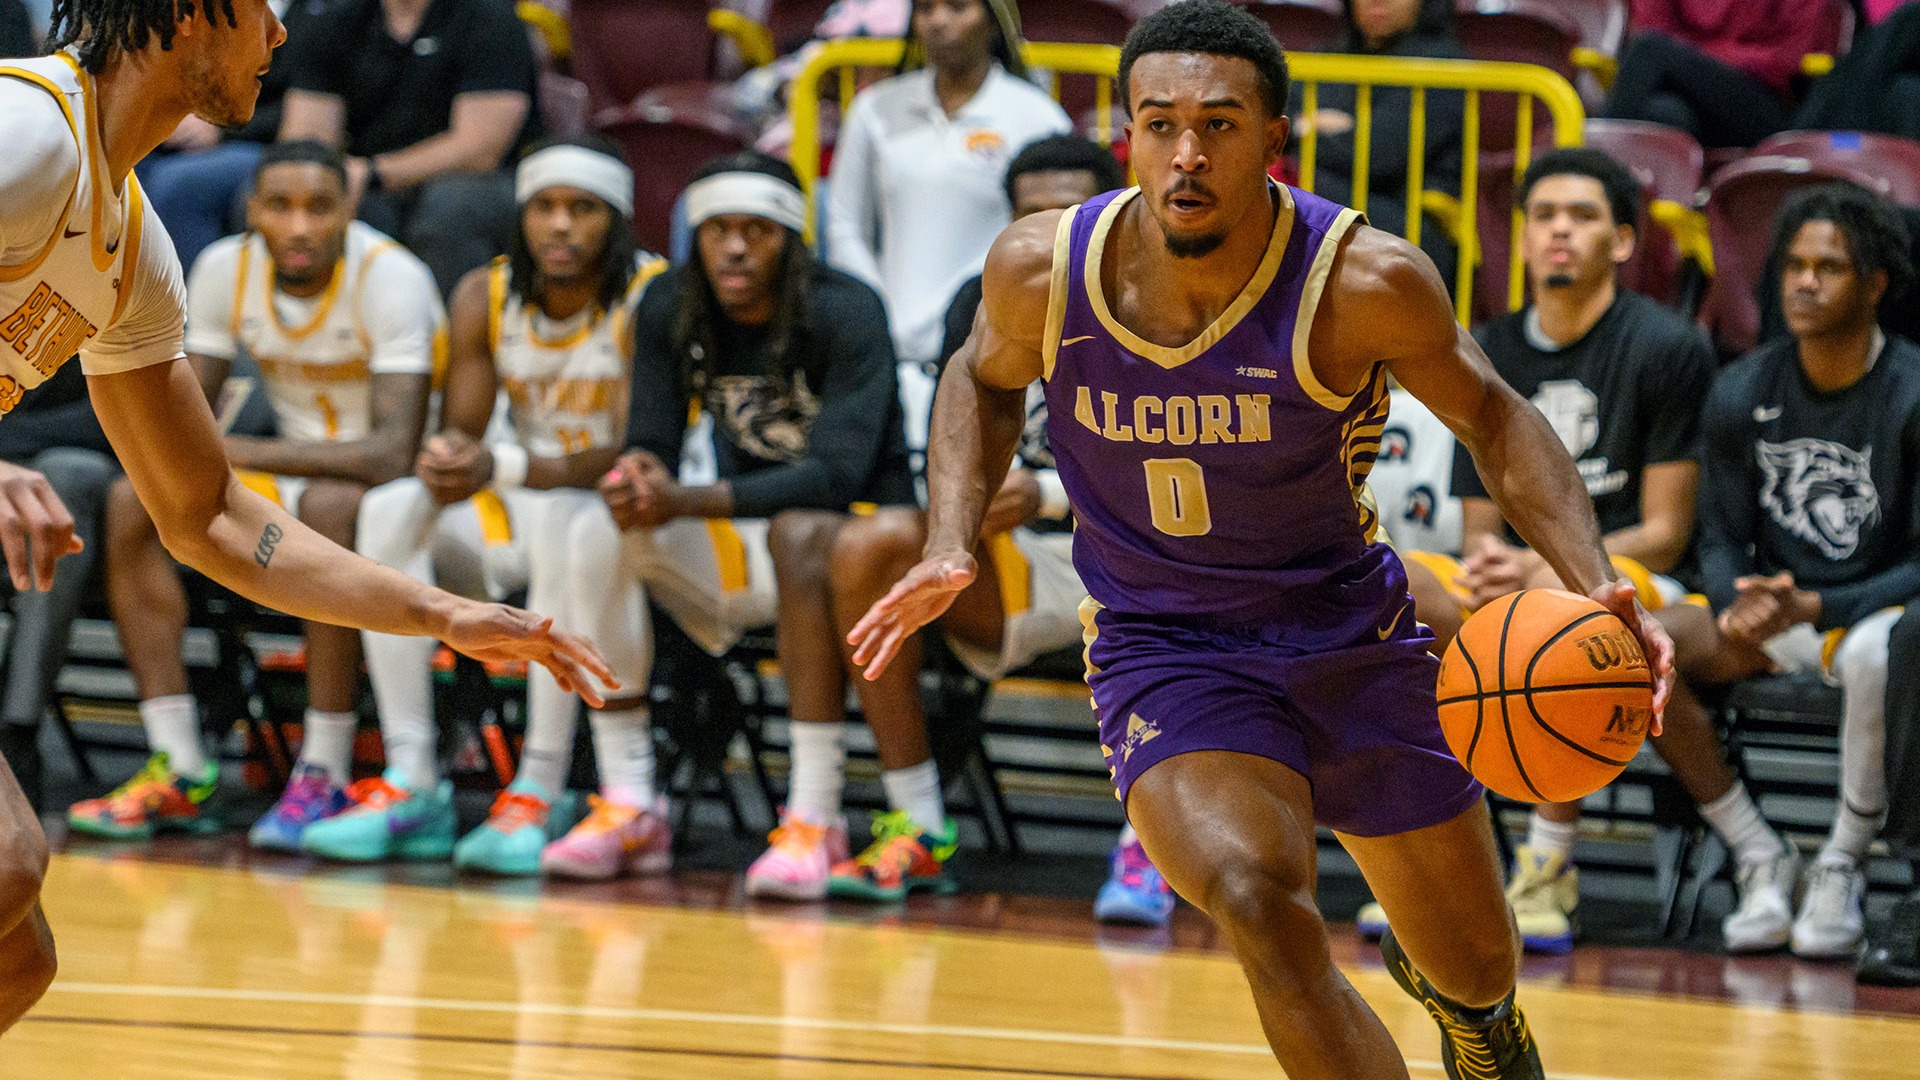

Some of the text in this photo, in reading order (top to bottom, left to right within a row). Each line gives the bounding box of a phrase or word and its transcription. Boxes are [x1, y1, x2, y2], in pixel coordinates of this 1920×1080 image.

[1246, 366, 1278, 379] SWAC
[1074, 385, 1272, 445] ALCORN
[1142, 457, 1213, 537] 0
